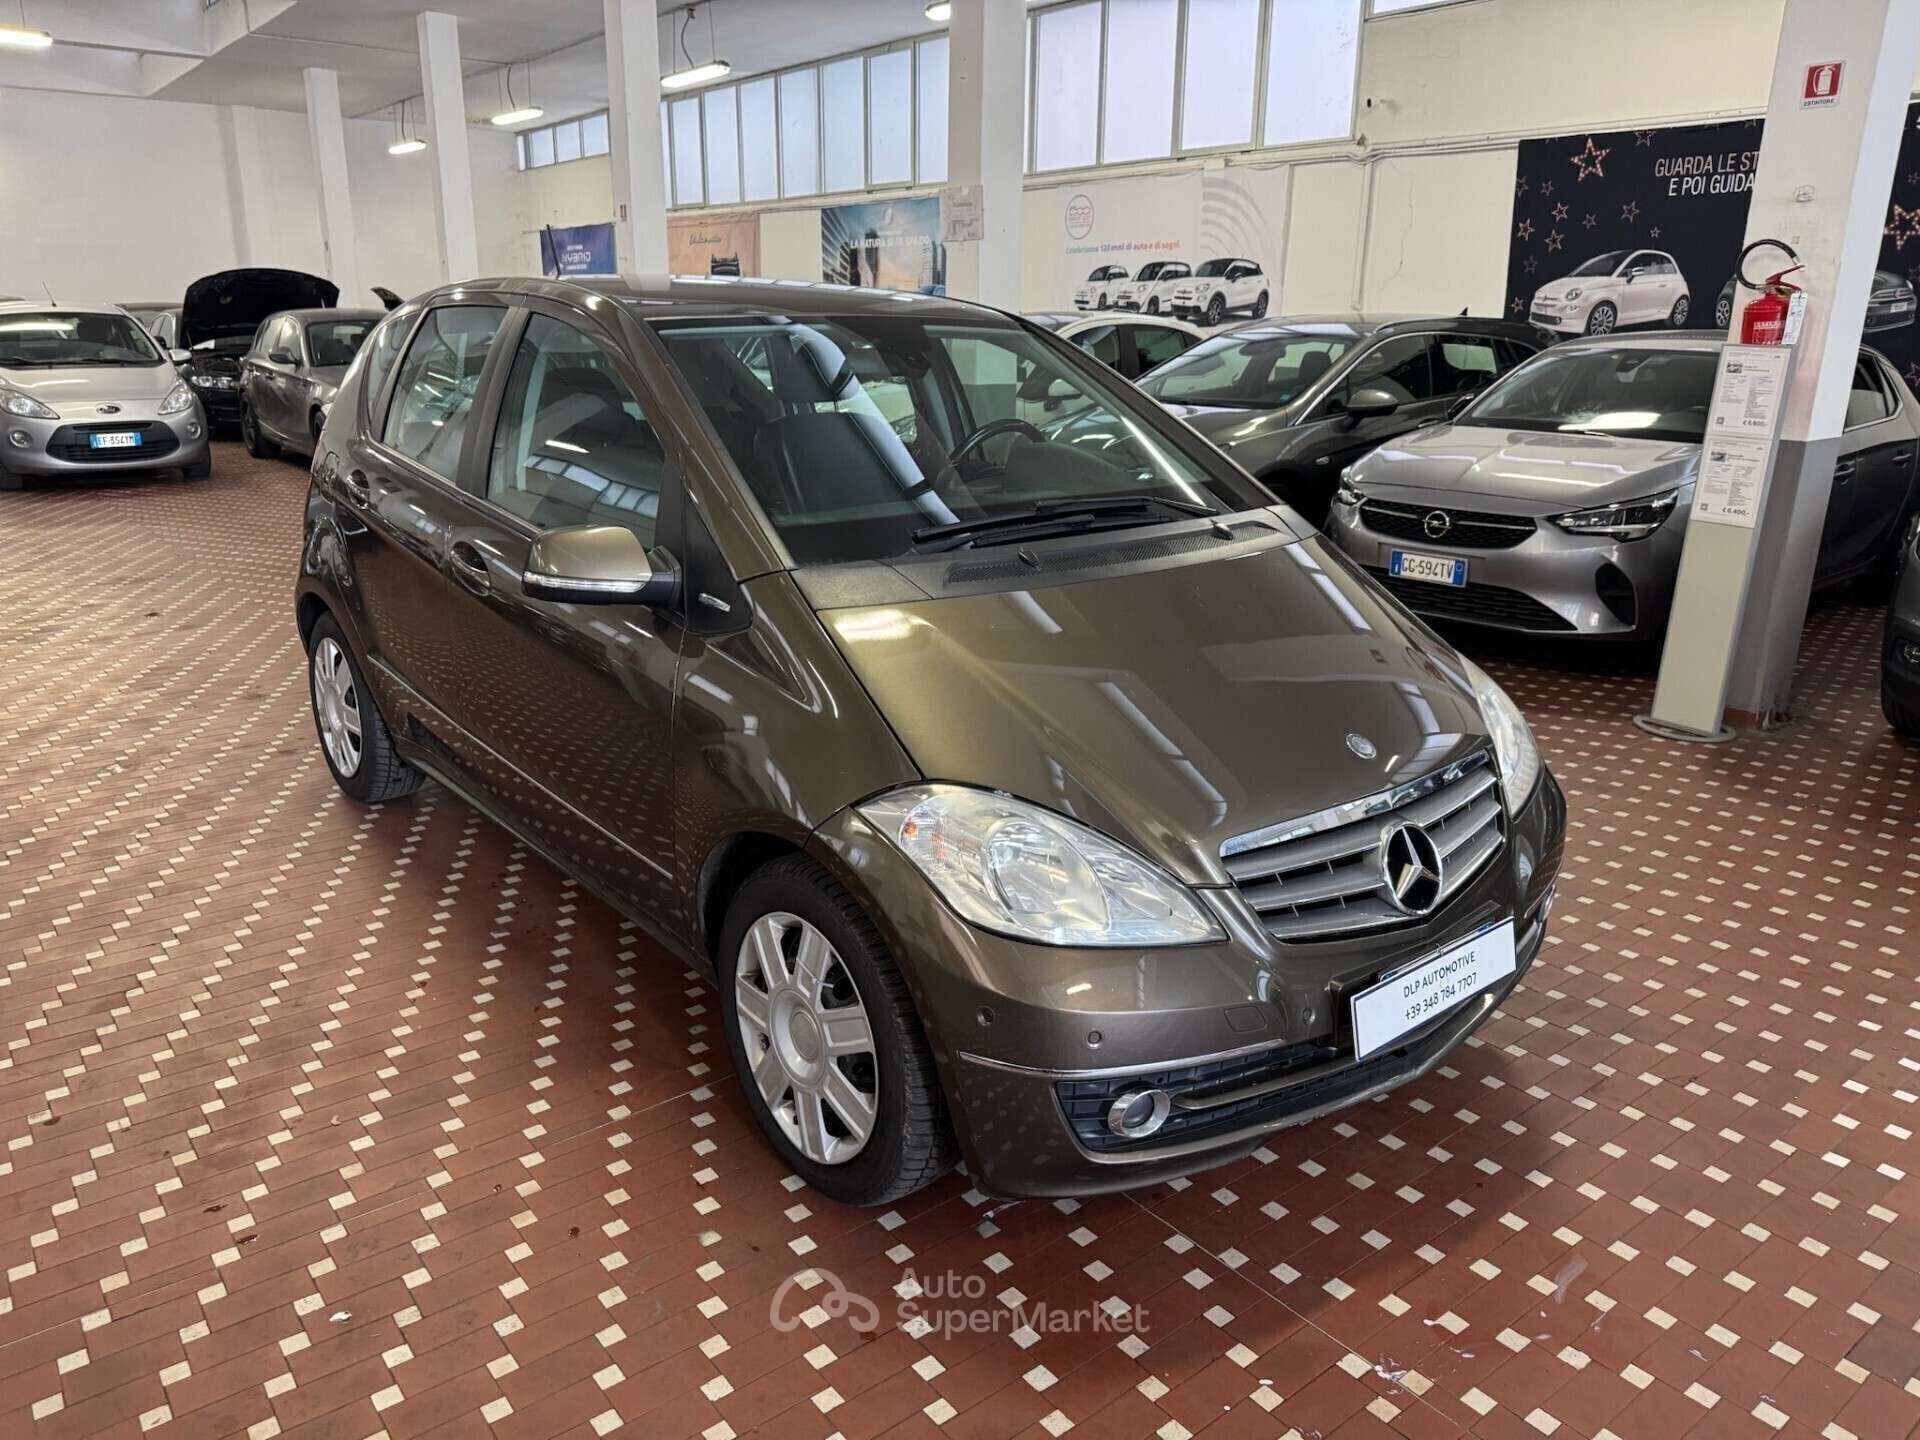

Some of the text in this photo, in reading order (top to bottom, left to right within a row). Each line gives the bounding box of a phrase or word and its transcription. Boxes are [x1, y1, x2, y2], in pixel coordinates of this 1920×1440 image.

[1655, 154, 1713, 177] GUARDA
[1717, 153, 1737, 173] LE
[1668, 173, 1755, 196] E POI GUIDA
[1403, 951, 1476, 998] DLP AUTOMOTIVE
[1405, 1003, 1421, 1020] +39
[1423, 992, 1439, 1012] 348
[1457, 972, 1477, 992] 7707
